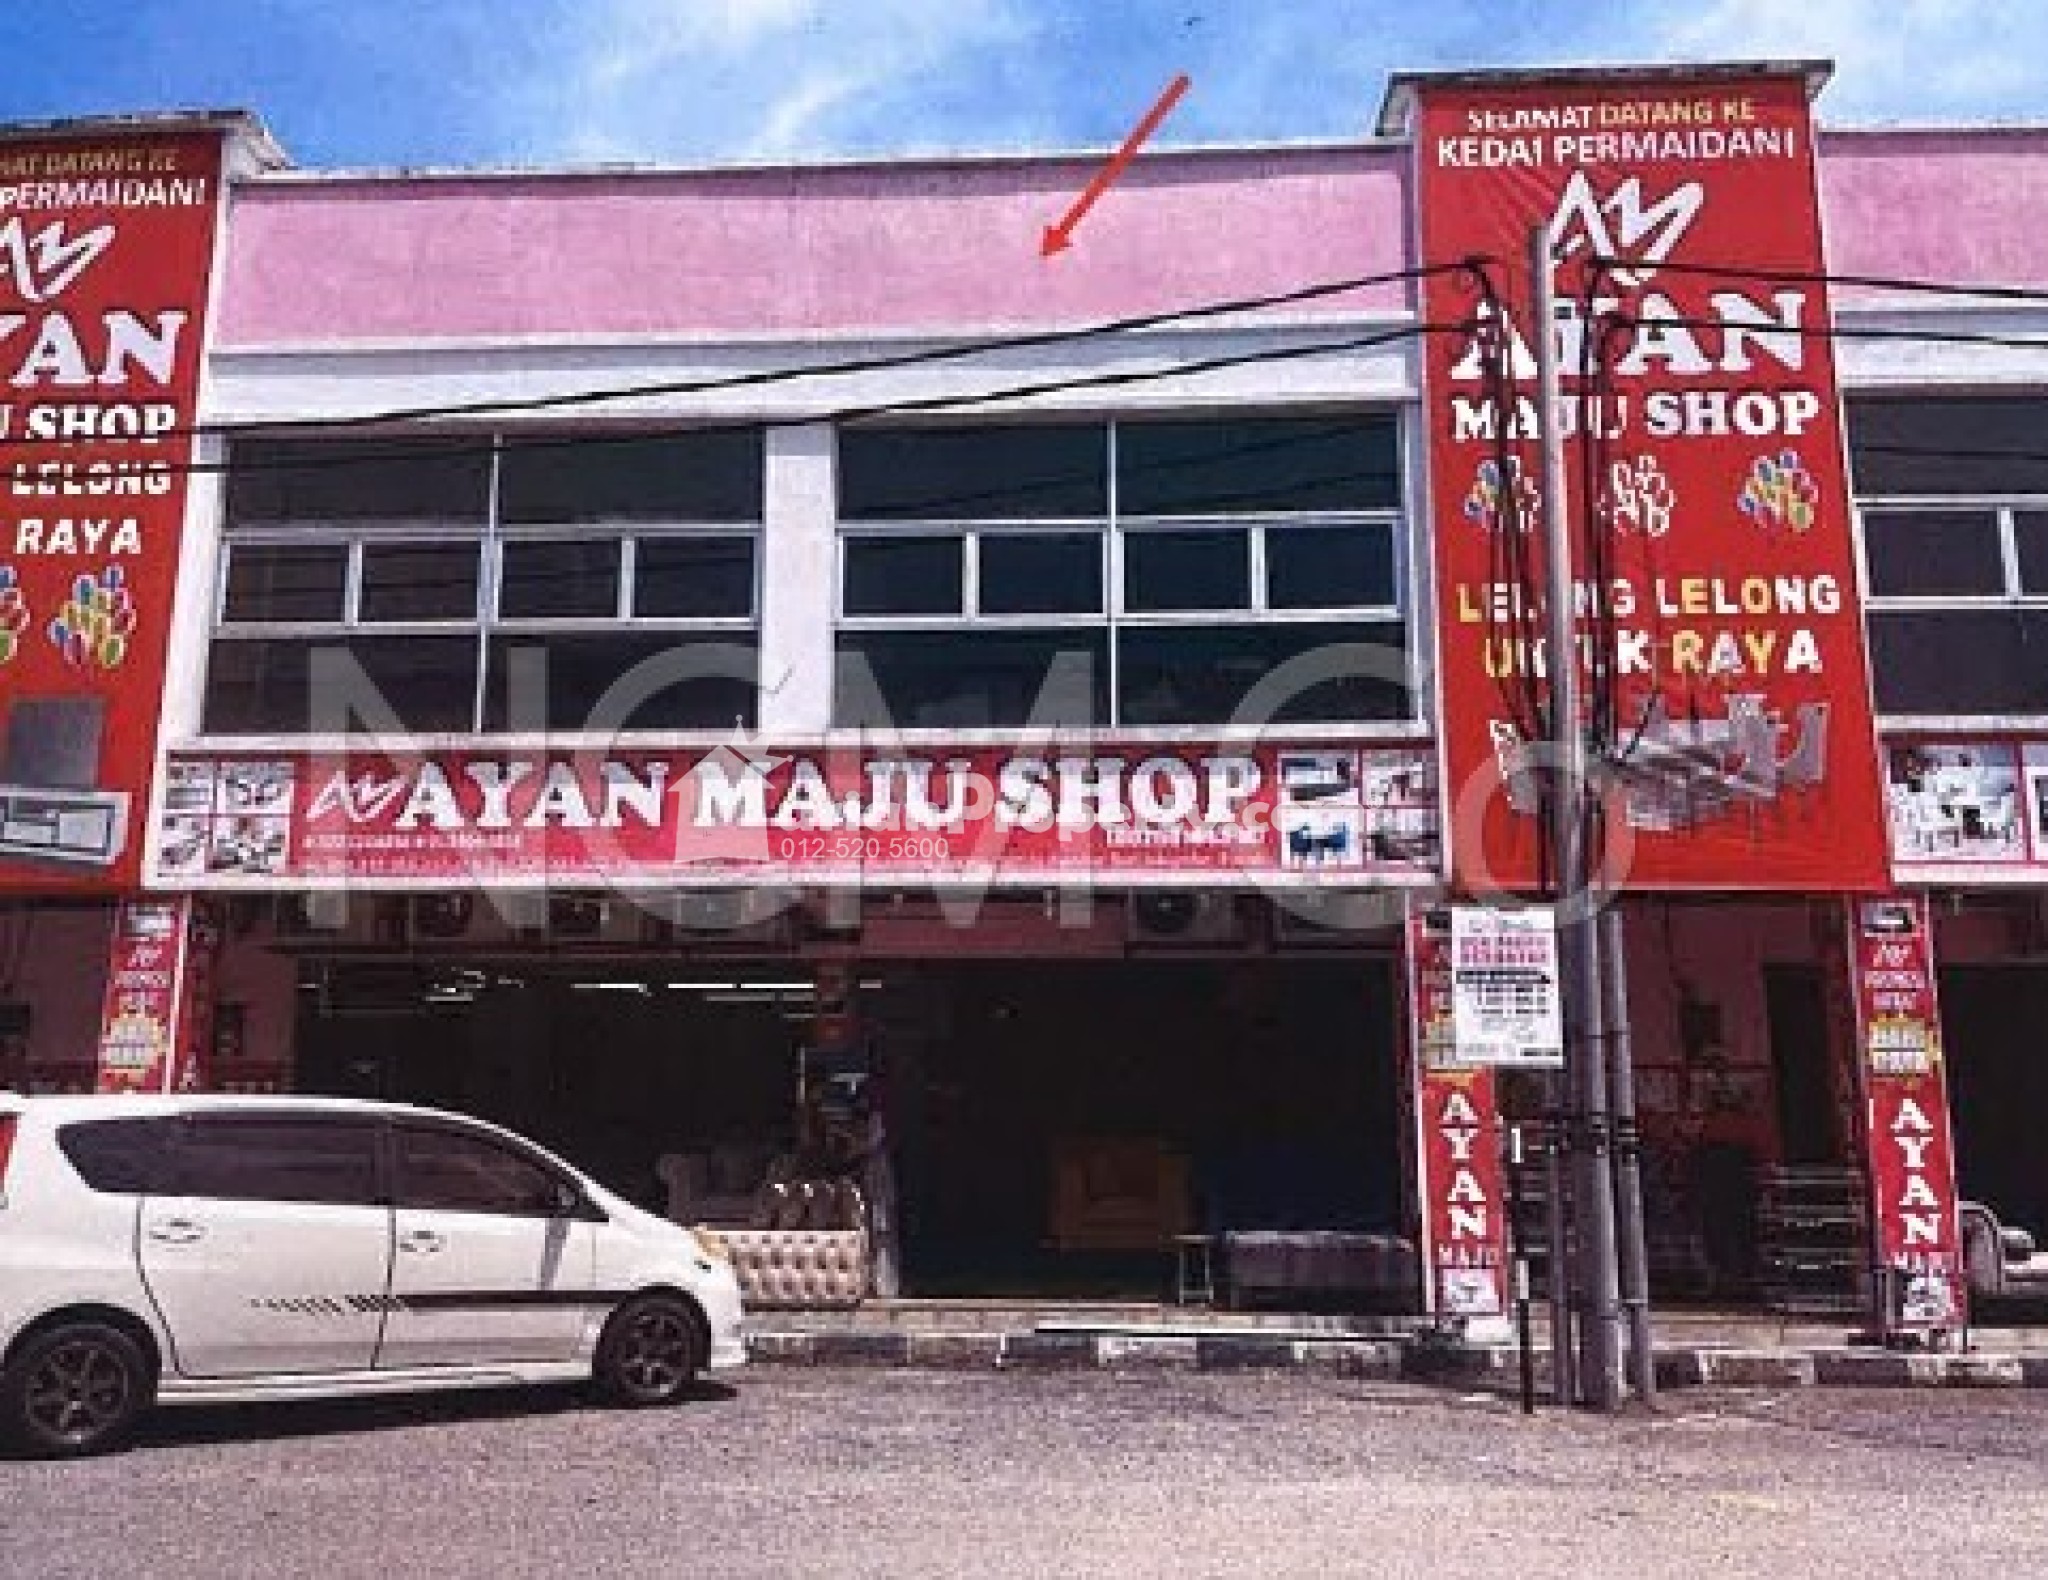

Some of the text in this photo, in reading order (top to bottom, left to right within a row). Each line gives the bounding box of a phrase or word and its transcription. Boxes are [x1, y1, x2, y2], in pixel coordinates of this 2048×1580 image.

[1600, 100, 1713, 126] DATANG
[1719, 98, 1756, 120] KE
[1438, 128, 1794, 167] KEDAI PERMAIDANI
[25, 402, 177, 446] SHOP
[1646, 391, 1819, 437] SHOP
[12, 461, 171, 496] LELONG
[15, 517, 142, 556] RAYA
[1656, 575, 1841, 620] LELONG
[1672, 629, 1823, 675] RAYA
[396, 757, 1263, 828] AYAN MAJU SHOP
